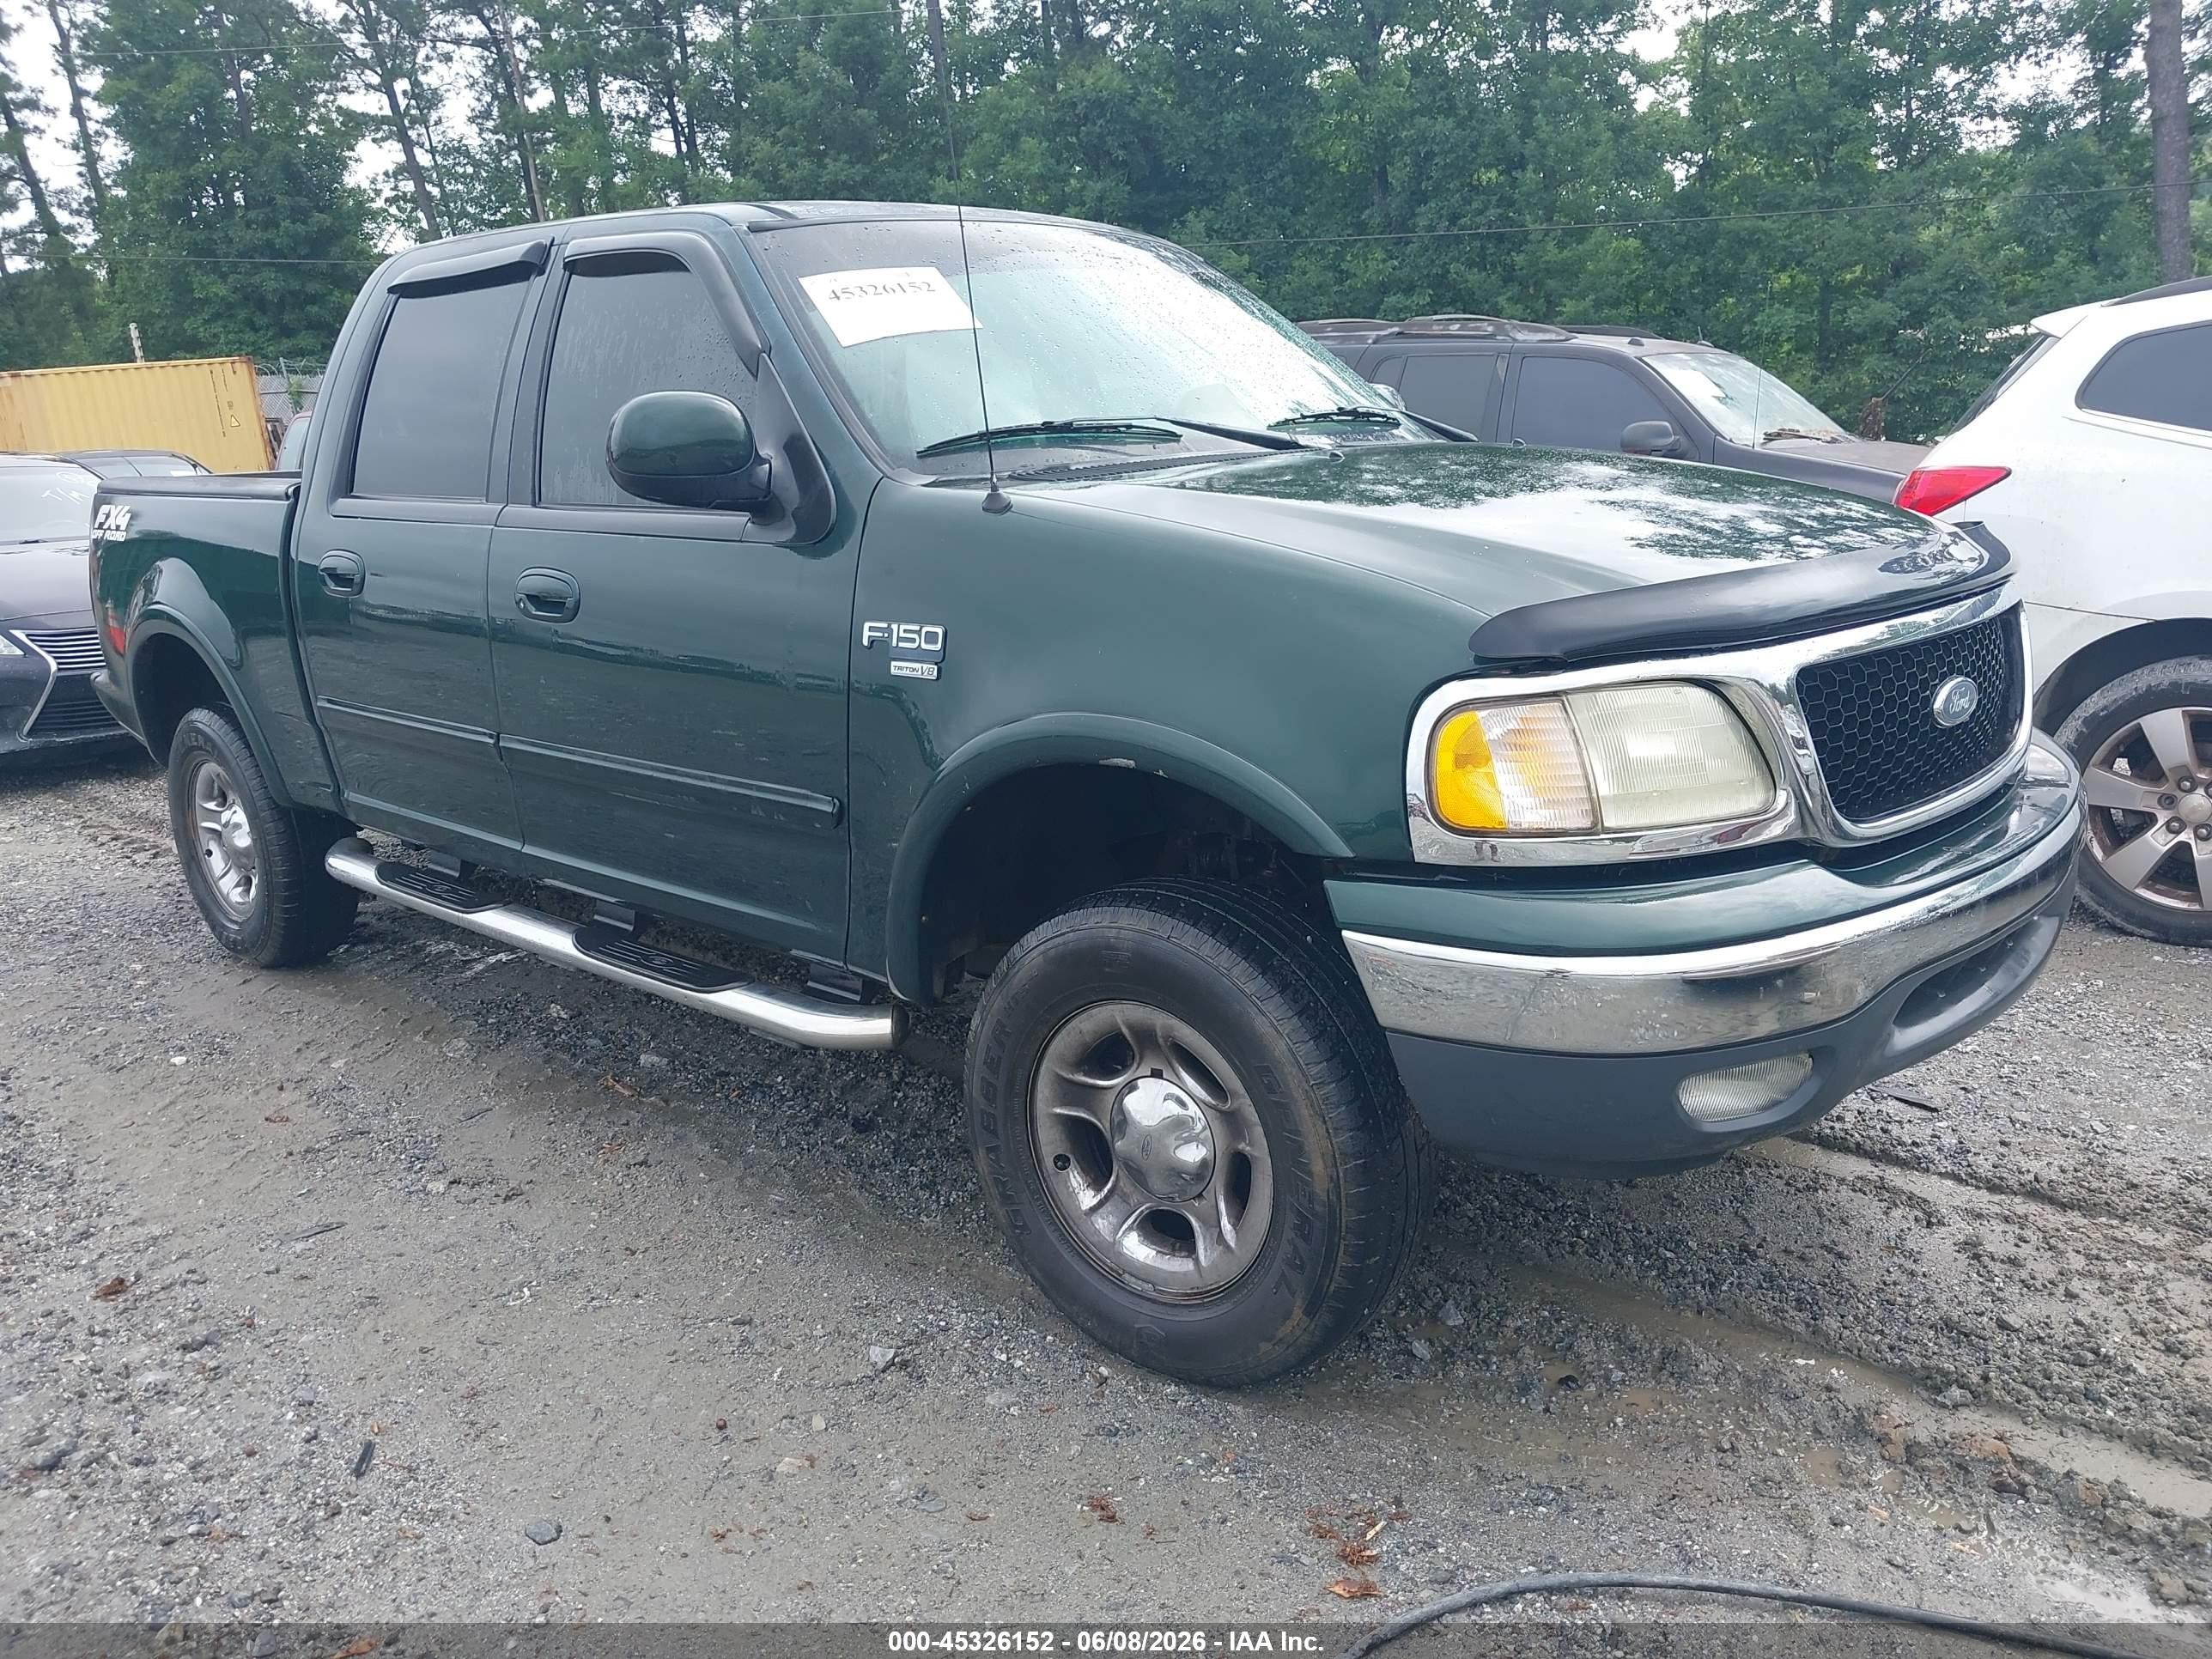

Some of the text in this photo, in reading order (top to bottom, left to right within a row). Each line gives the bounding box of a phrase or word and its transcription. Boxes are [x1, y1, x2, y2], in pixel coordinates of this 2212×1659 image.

[830, 282, 936, 301] 45326152
[94, 504, 131, 531] FX4
[92, 529, 126, 542] OFF ROAD
[921, 666, 935, 677] V8
[1949, 687, 1971, 714] Ford
[1254, 1064, 1314, 1298] GENERAL
